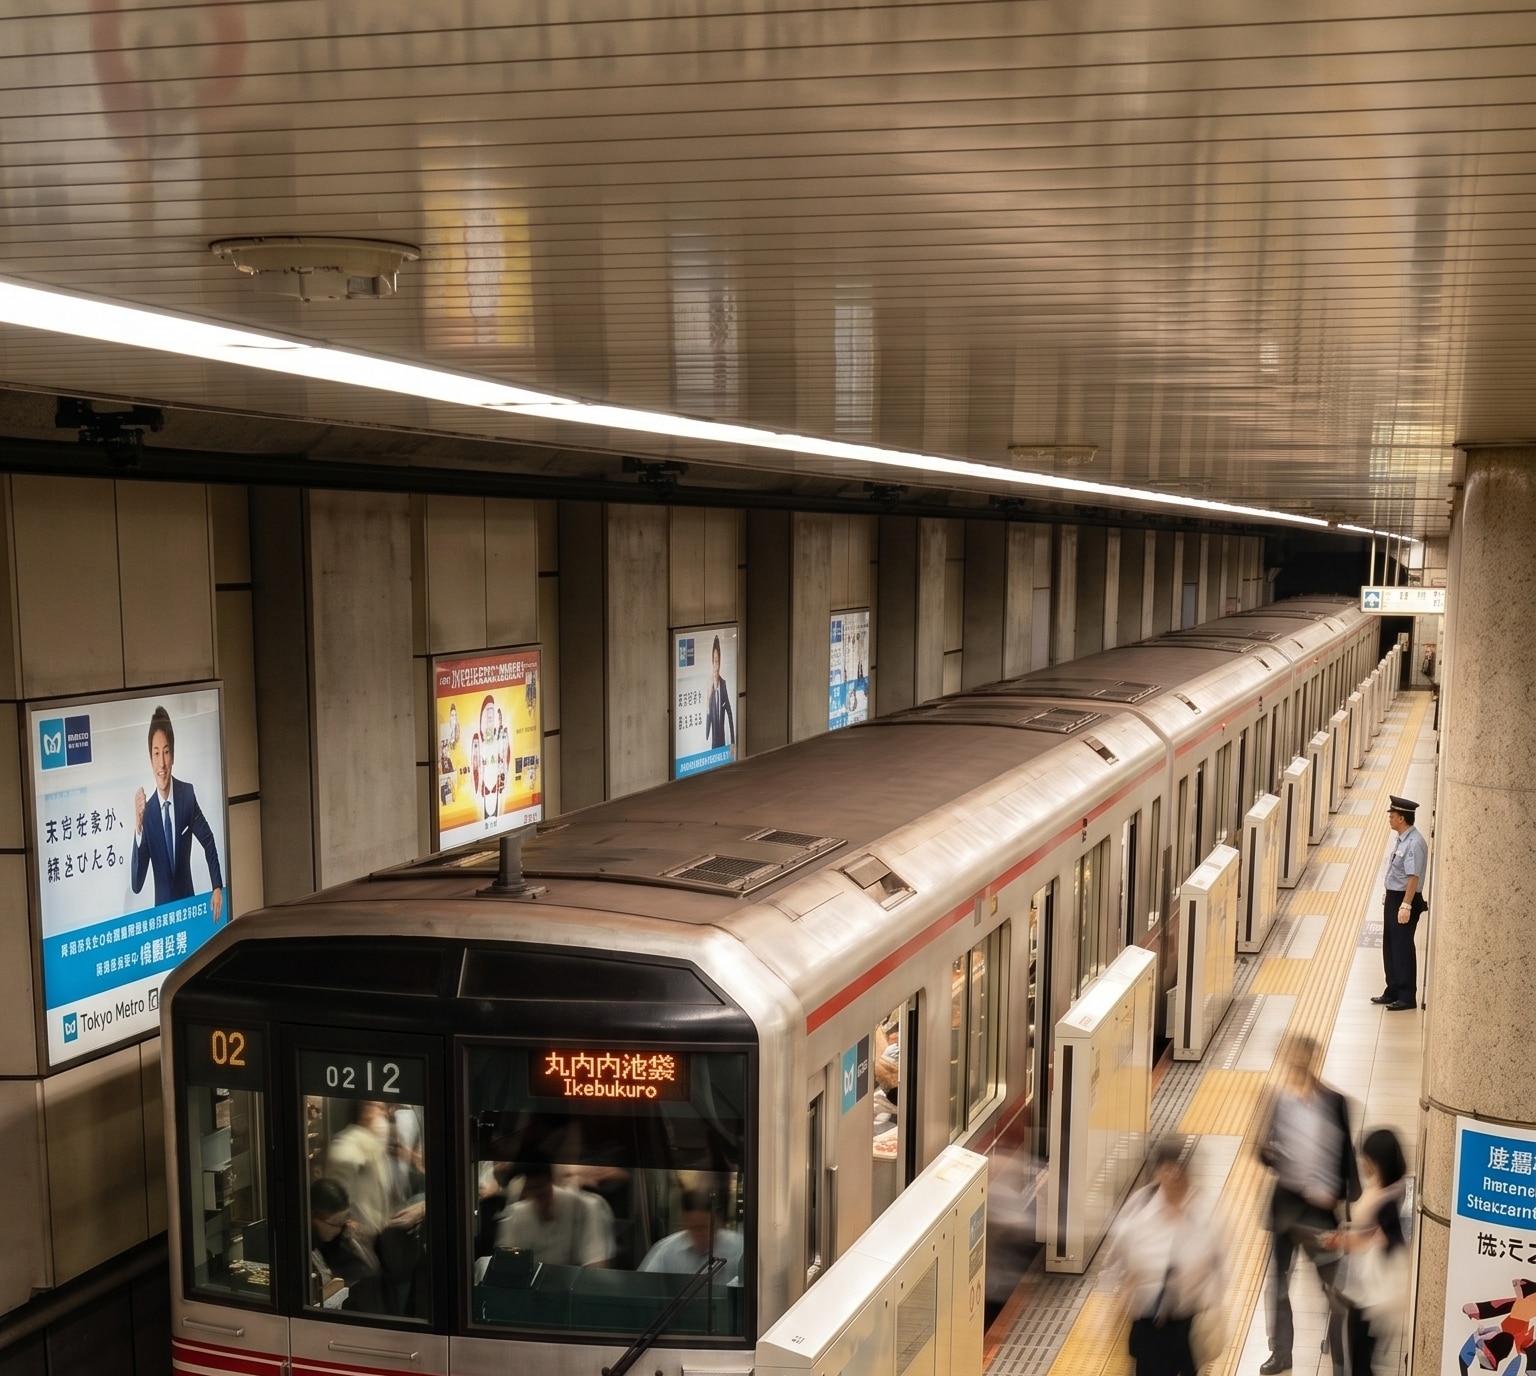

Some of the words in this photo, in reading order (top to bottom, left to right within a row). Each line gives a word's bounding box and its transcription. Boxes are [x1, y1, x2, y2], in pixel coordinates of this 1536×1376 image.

[80, 1010, 113, 1033] Tokyo
[115, 999, 145, 1021] Metro
[211, 1030, 246, 1066] 02
[563, 1078, 657, 1099] Ikebukuro
